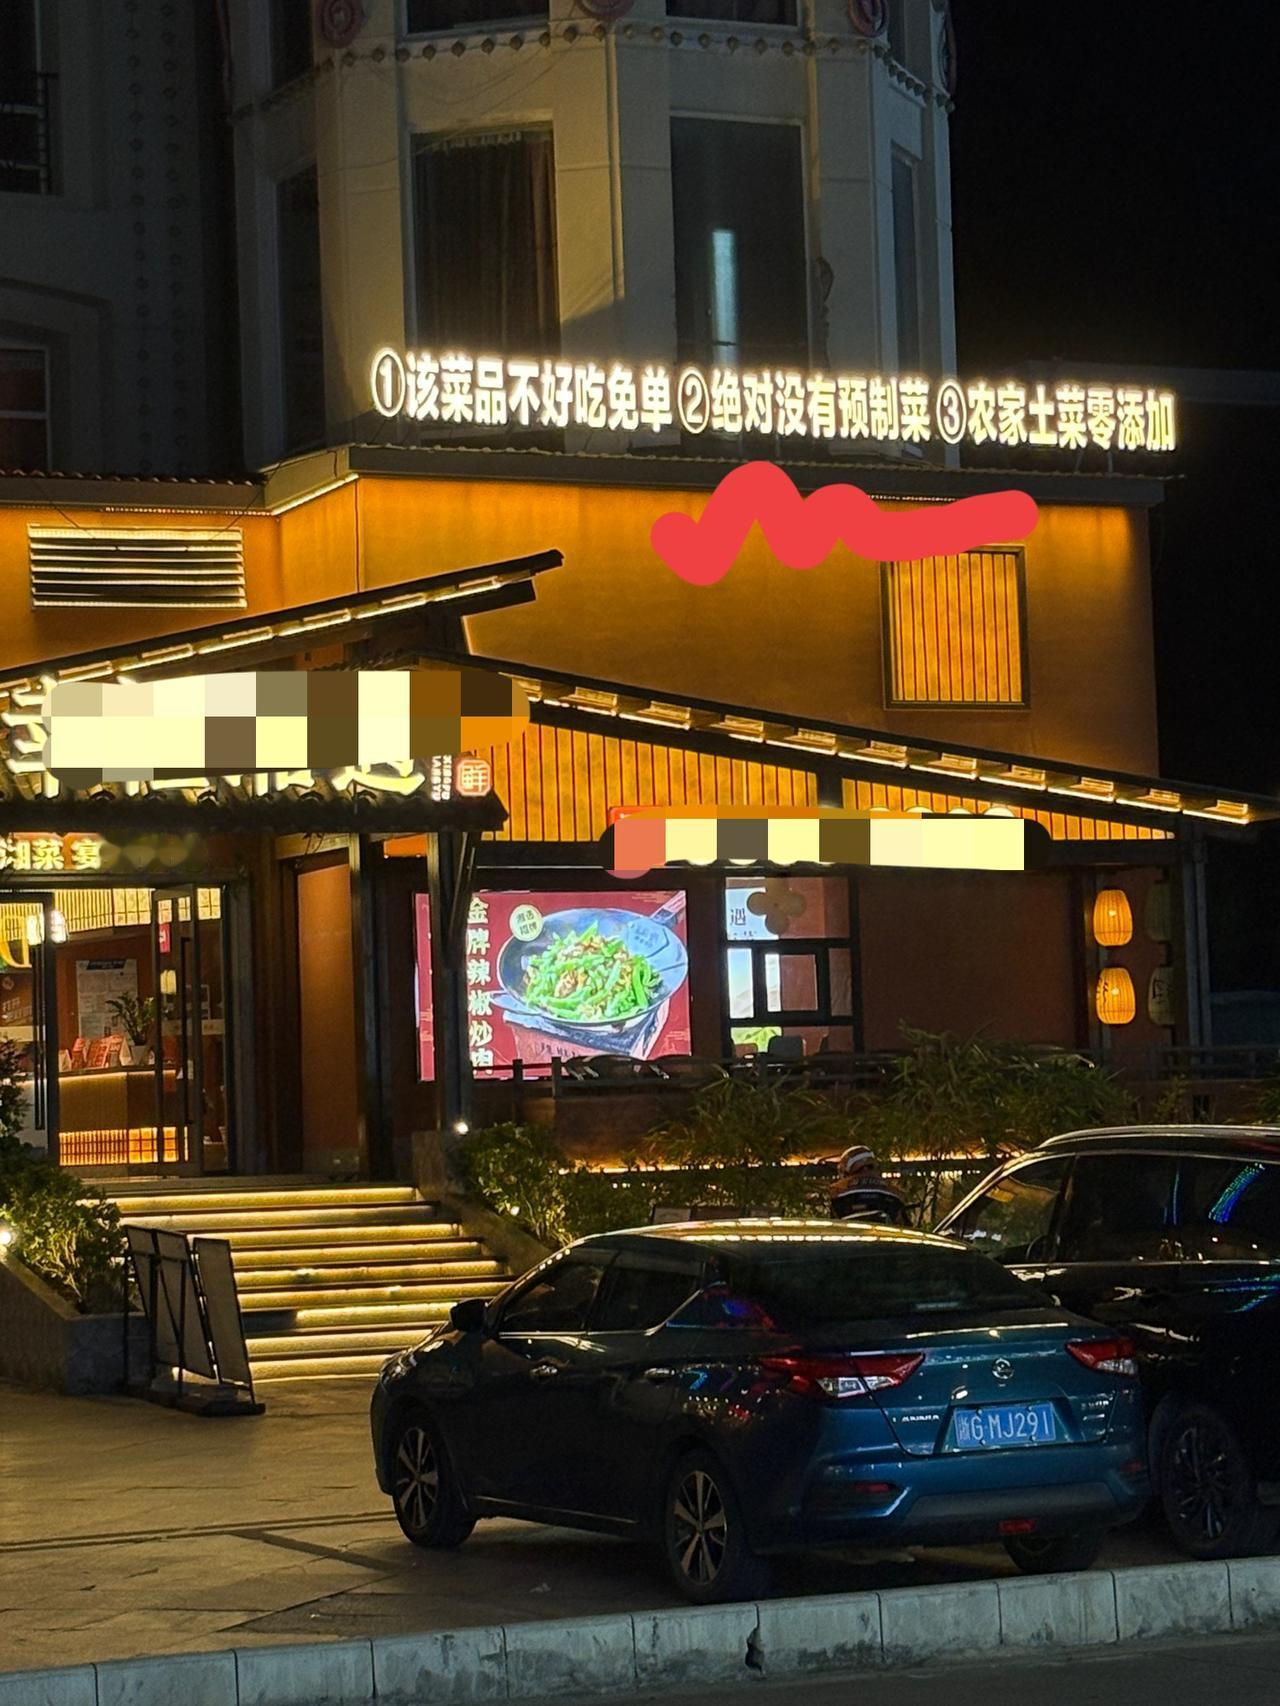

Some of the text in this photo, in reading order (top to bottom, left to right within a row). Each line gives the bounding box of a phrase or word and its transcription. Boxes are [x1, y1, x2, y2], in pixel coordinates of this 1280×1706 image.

[371, 347, 1177, 451] ①该菜品不好吃免单 ②绝对没有预制菜 ③农家土菜零添加
[467, 897, 494, 1076] 金牌辣椒炒肉
